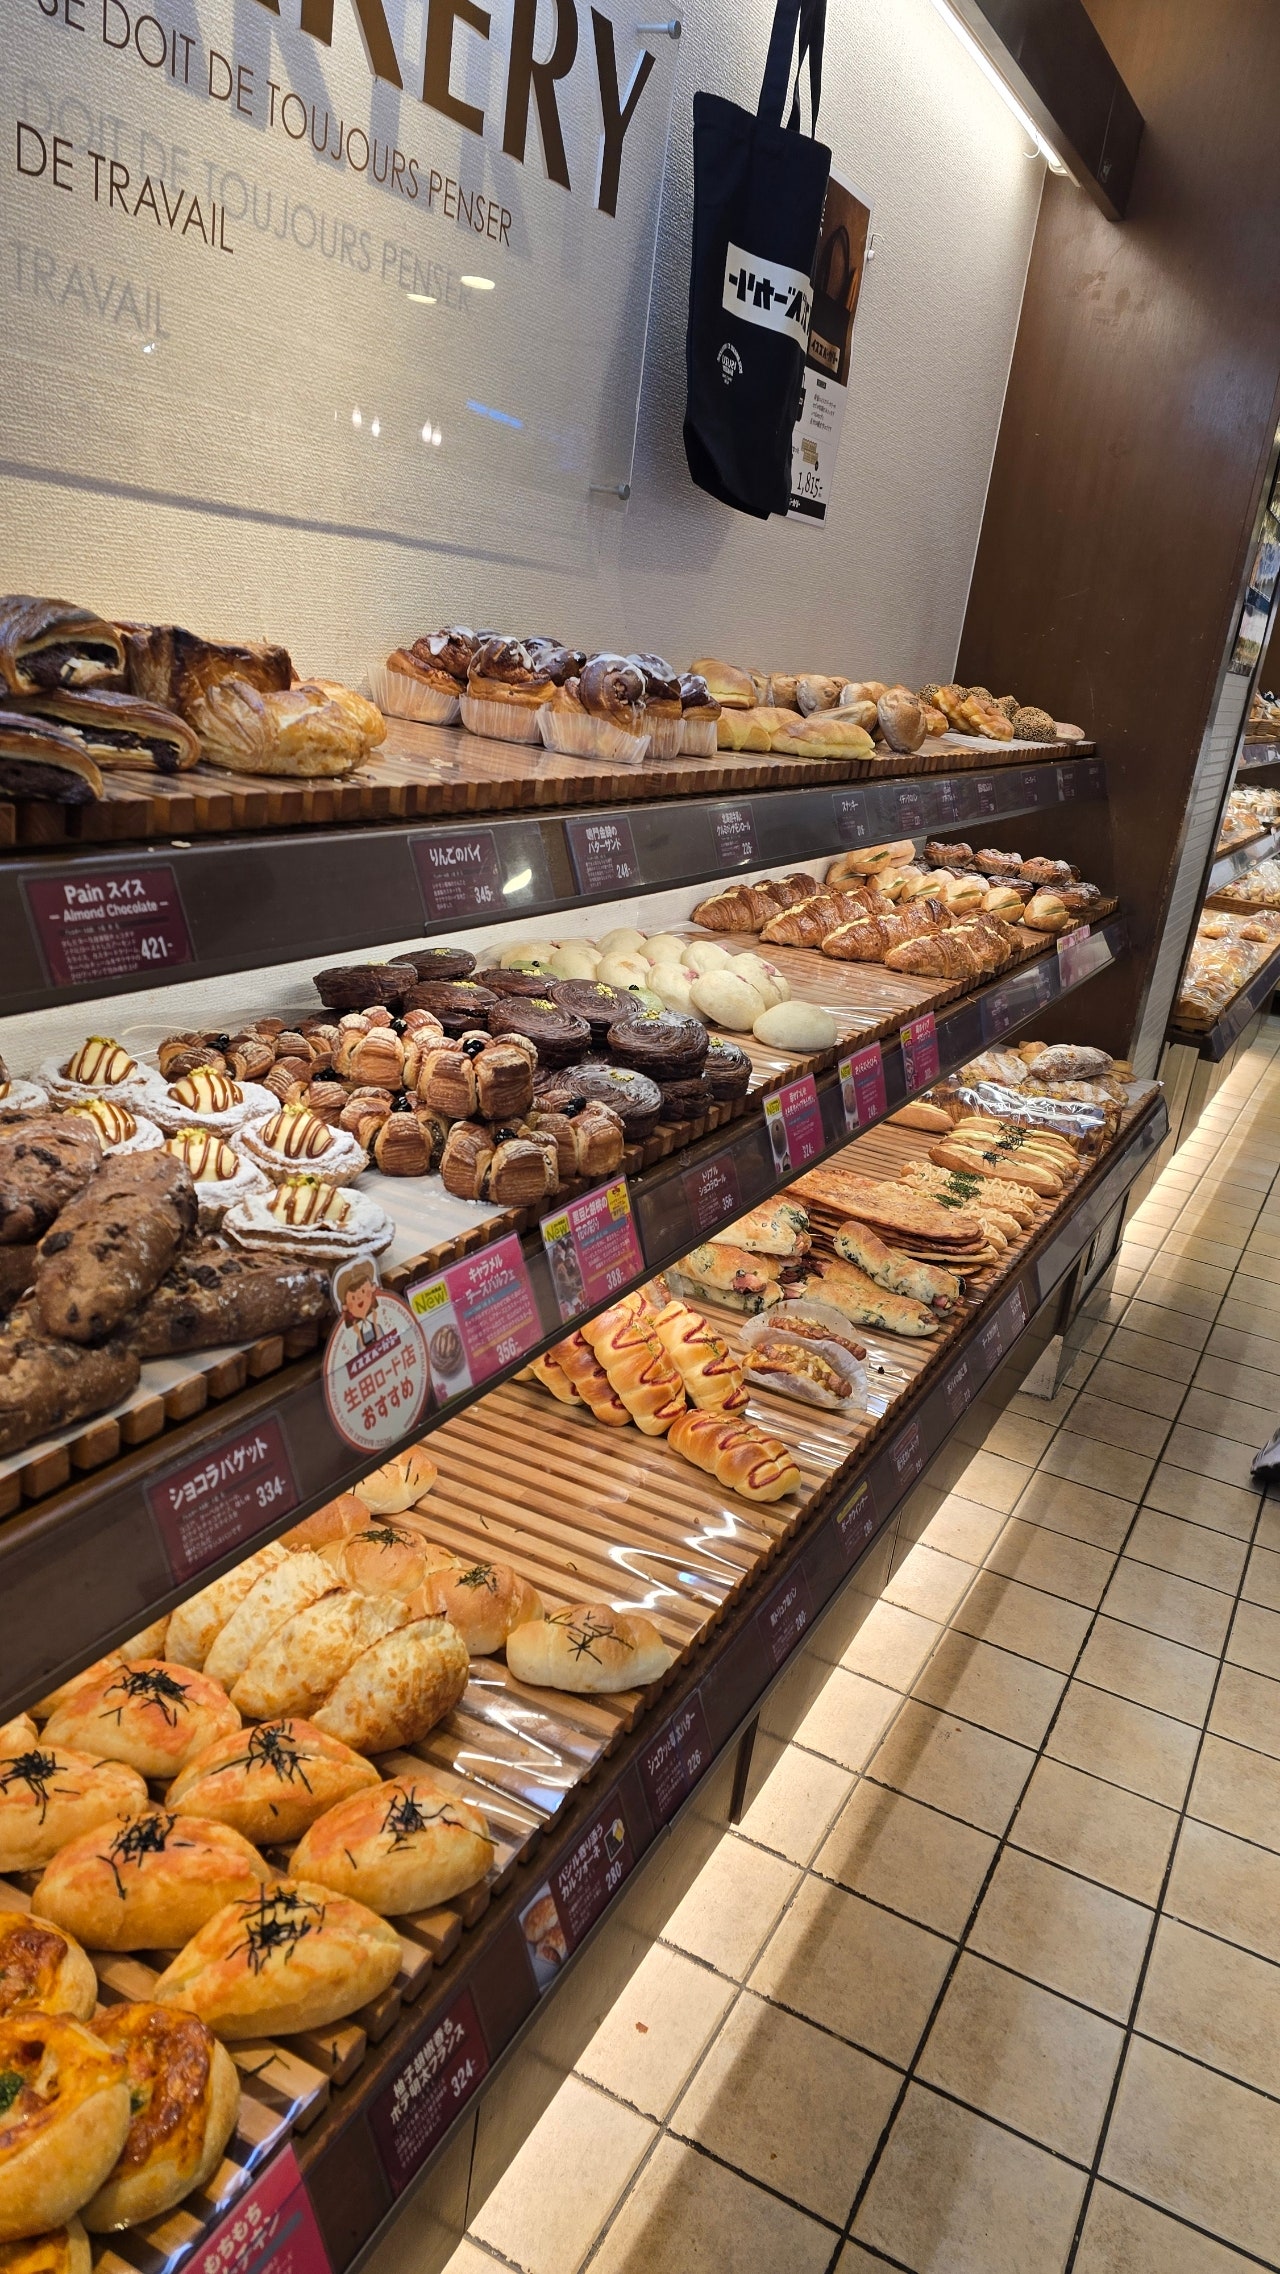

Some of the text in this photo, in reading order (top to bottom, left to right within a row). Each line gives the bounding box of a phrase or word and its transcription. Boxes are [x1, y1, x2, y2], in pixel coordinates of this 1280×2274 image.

[102, 0, 196, 84] DOIT
[208, 49, 254, 116] DE
[266, 80, 419, 199] TOUJOURS
[428, 168, 513, 247] PENSER
[17, 121, 234, 254] DE TRAVAIL
[429, 843, 481, 867] りんごのパイ
[63, 900, 158, 922] Almond Chocolate
[64, 879, 146, 905] Pain スイス
[469, 1254, 503, 1283] キャラメル
[343, 1343, 417, 1414] 生田ロード店
[361, 1376, 414, 1430] おすすめ
[168, 1437, 268, 1511] ショコラバゲット
[561, 1844, 600, 1902] カルツォーネ
[204, 2202, 262, 2274] もちもち
